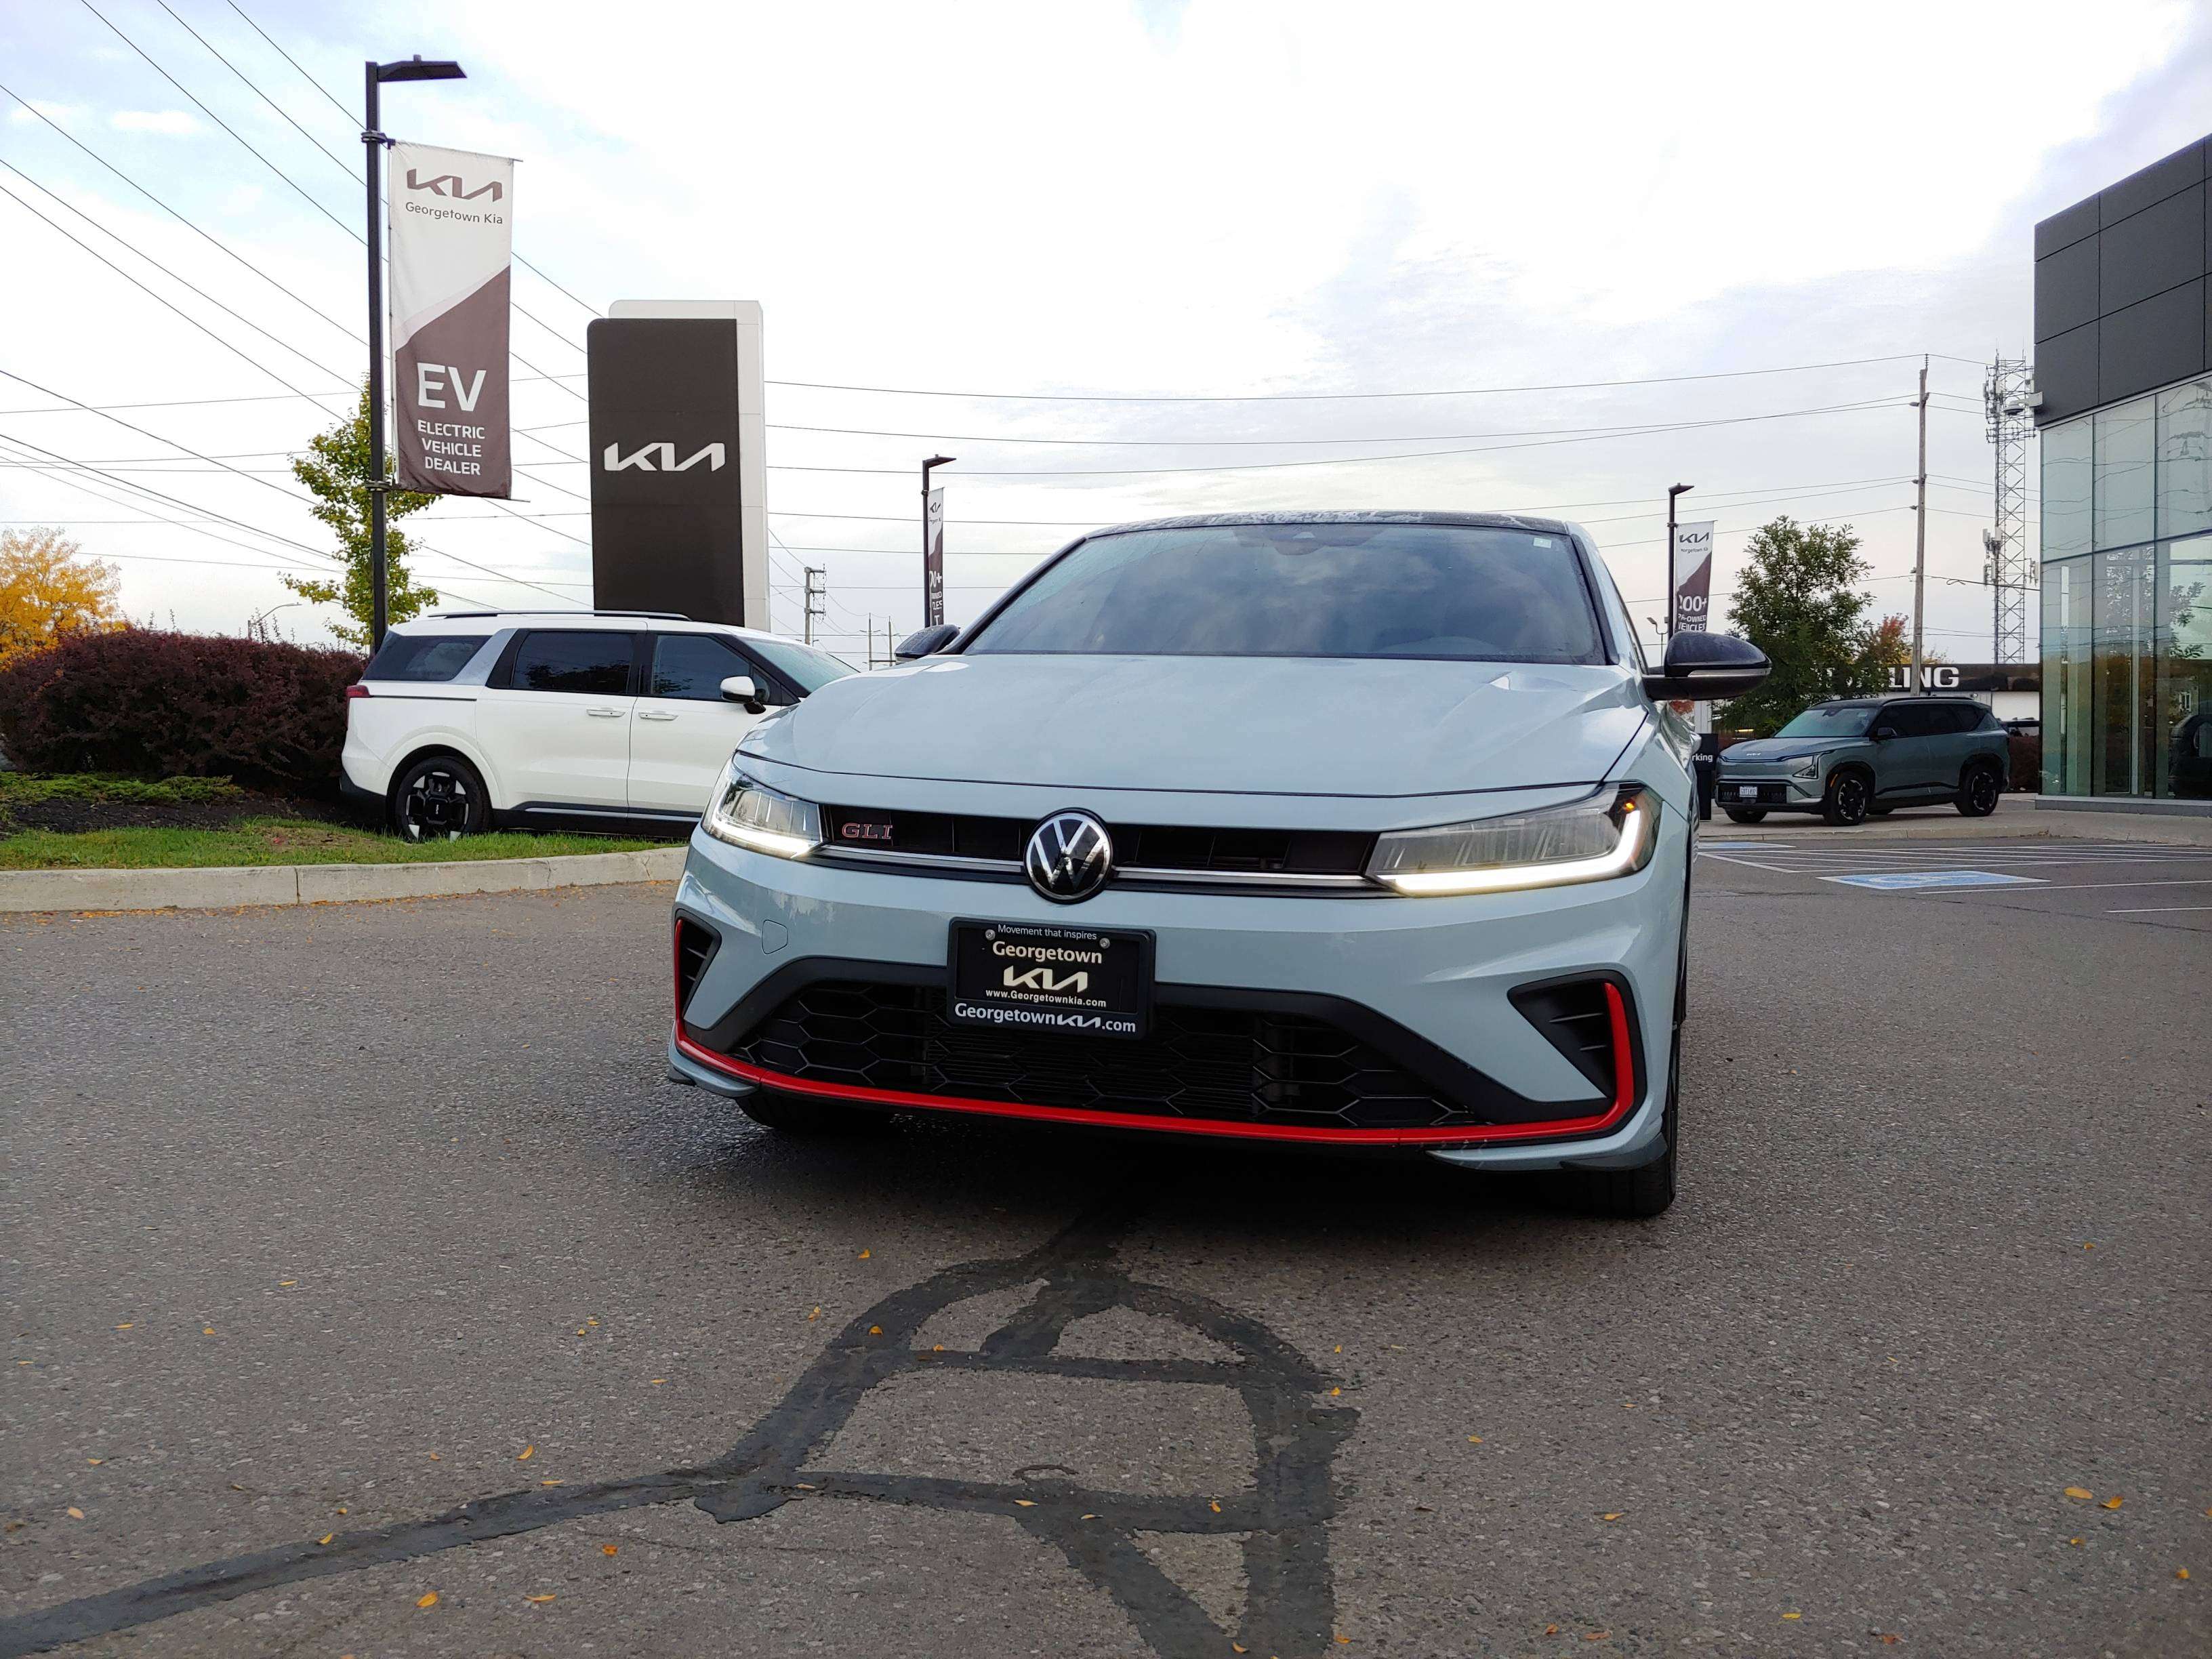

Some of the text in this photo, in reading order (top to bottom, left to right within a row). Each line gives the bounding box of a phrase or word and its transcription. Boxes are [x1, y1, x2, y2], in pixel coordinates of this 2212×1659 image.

[407, 168, 503, 203] KIA
[405, 202, 503, 224] Georgetown Kia
[417, 362, 487, 412] EV
[417, 419, 485, 439] ELECTRIC
[421, 438, 482, 457] VEHICLE
[604, 442, 726, 472] KIA
[425, 456, 481, 476] DEALER
[1679, 532, 1709, 544] KIA
[1692, 753, 1713, 762] rking
[842, 822, 893, 840] GLI
[998, 924, 1097, 941] Movement that inspires
[992, 941, 1103, 964] Georgetown
[1004, 965, 1088, 993] KIA
[985, 989, 1107, 1008] www.Georgetownkia.com
